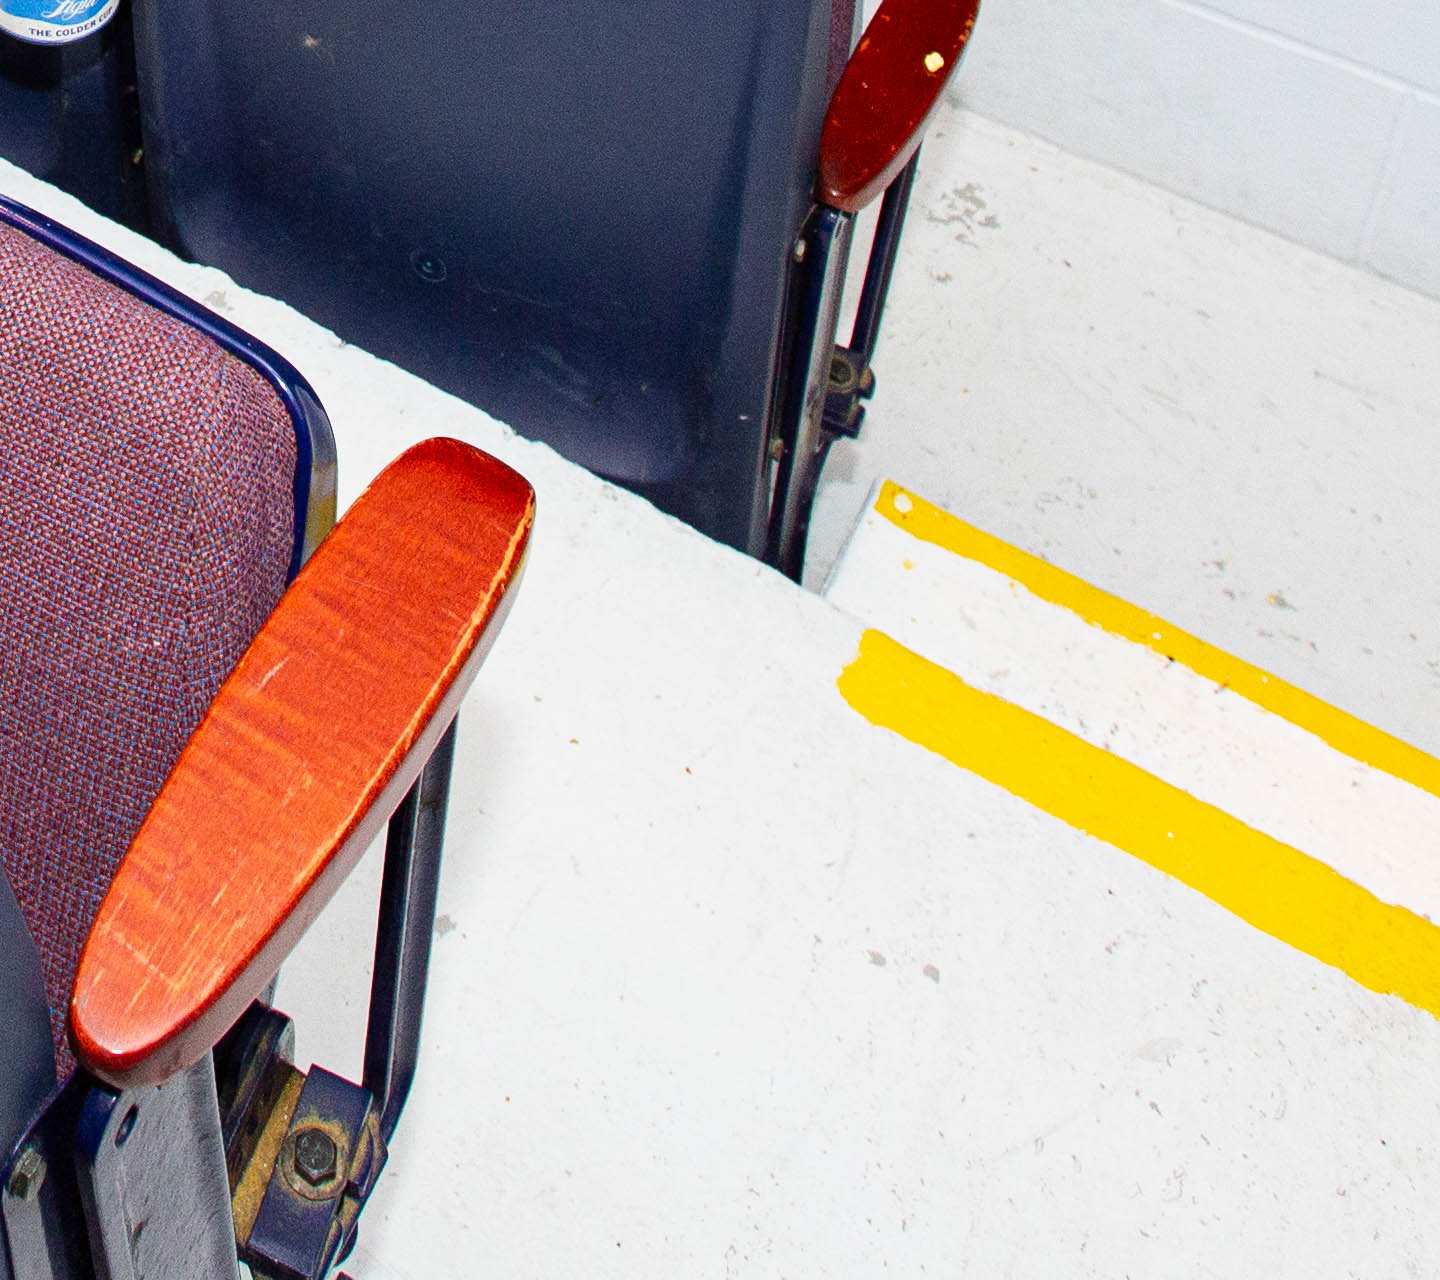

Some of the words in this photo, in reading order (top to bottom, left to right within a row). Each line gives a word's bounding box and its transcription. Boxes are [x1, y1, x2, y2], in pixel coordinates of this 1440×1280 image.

[28, 27, 53, 37] THE
[55, 19, 97, 37] COLDER
[98, 6, 113, 23] CUP
